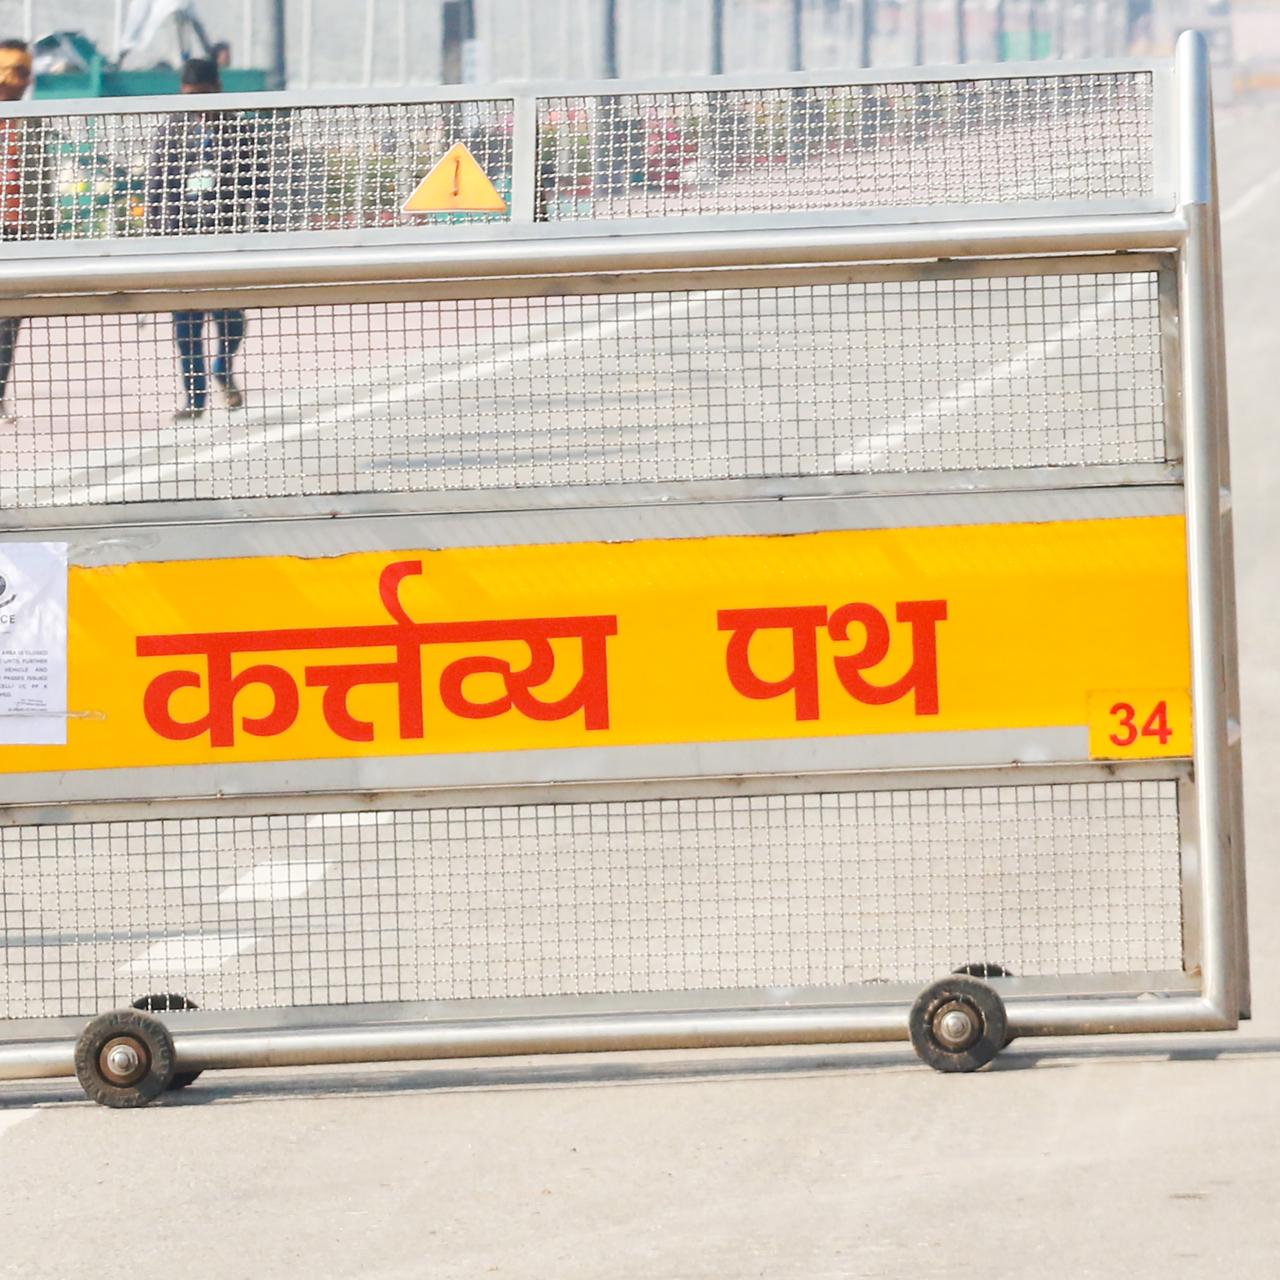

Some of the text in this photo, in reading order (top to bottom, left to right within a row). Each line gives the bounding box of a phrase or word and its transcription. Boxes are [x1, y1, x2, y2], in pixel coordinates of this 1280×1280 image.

[136, 560, 948, 748] कर्त्तव्य पथ
[1109, 701, 1173, 747] 34
